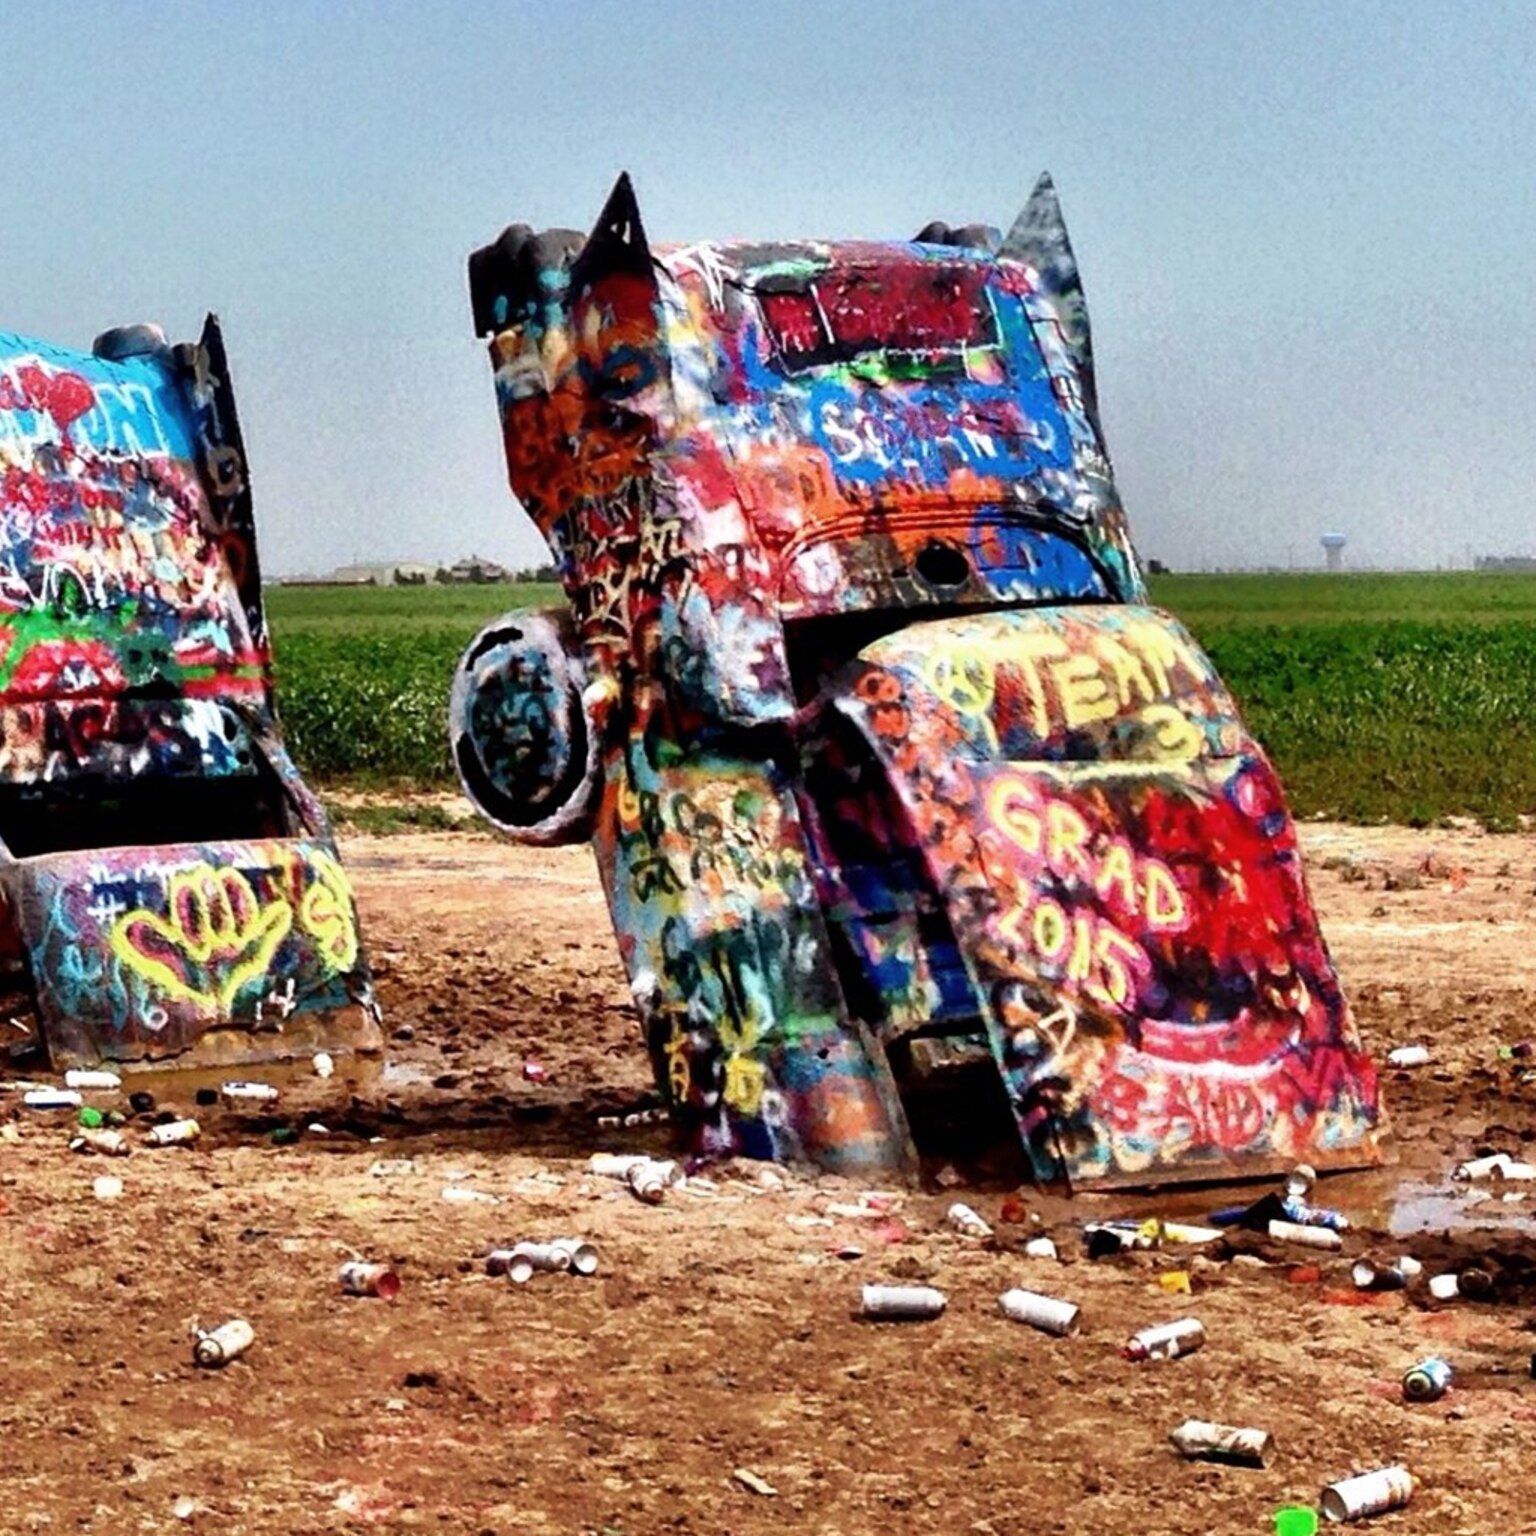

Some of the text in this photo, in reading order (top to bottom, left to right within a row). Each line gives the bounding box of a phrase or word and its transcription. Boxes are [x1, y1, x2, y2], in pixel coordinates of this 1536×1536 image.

[986, 621, 1208, 741] TEAM
[1139, 703, 1207, 760] 3
[986, 775, 1187, 926] GRAD
[994, 875, 1144, 1008] 2015
